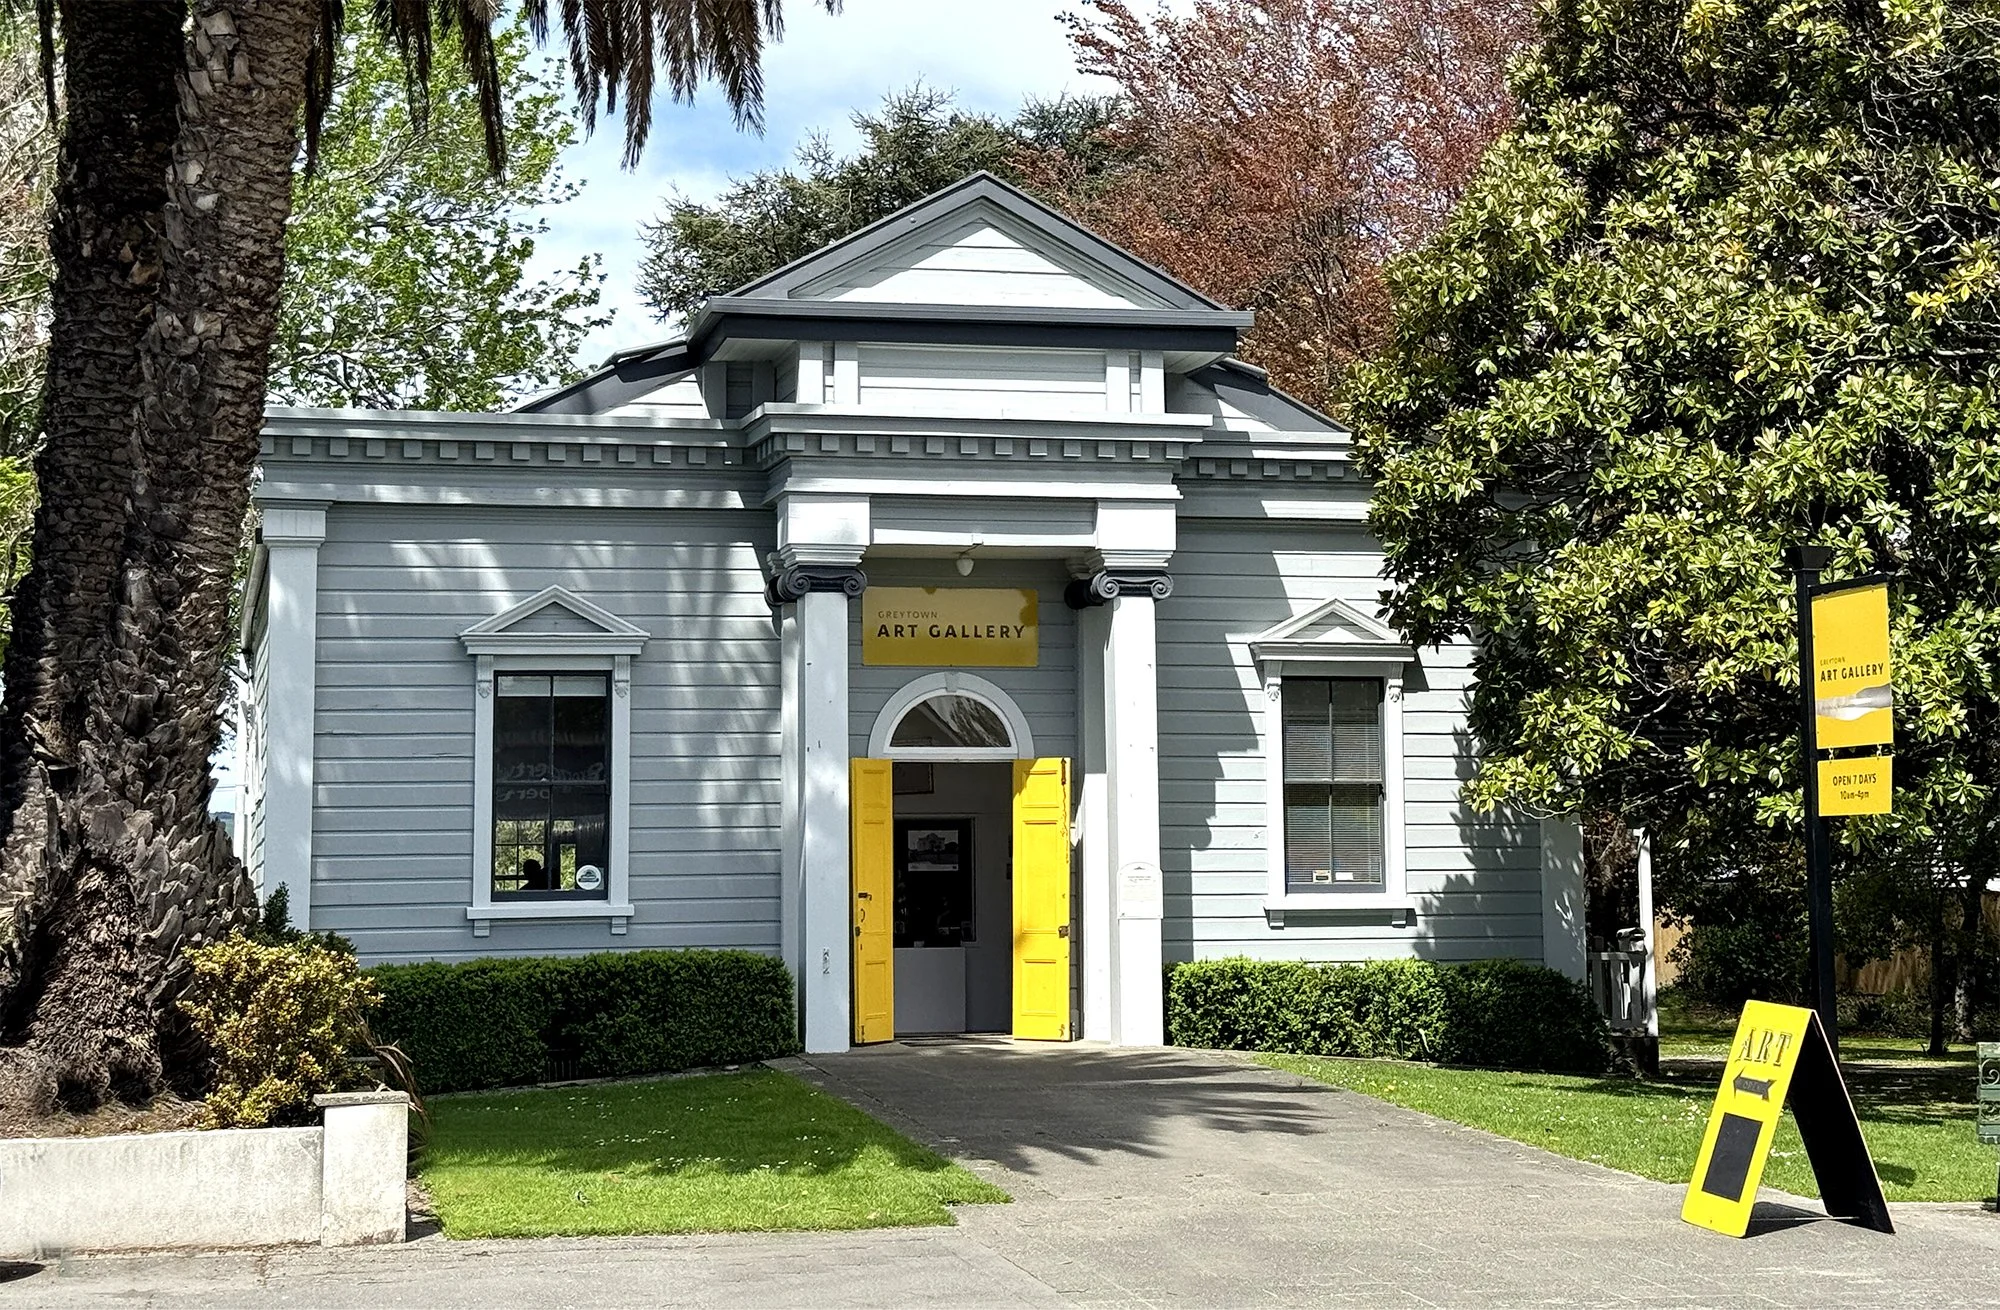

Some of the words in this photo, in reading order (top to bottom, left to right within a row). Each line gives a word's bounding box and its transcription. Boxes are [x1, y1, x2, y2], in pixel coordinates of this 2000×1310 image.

[877, 610, 938, 619] GREYTOWN
[877, 624, 918, 638] ART
[928, 624, 1026, 639] GALLERY
[1820, 669, 1838, 682] ART
[1841, 662, 1884, 679] GALLERY
[1832, 775, 1851, 786] OPEN
[1853, 774, 1858, 785] 7
[1858, 773, 1877, 785] DAYS
[1735, 1027, 1793, 1068] ART
